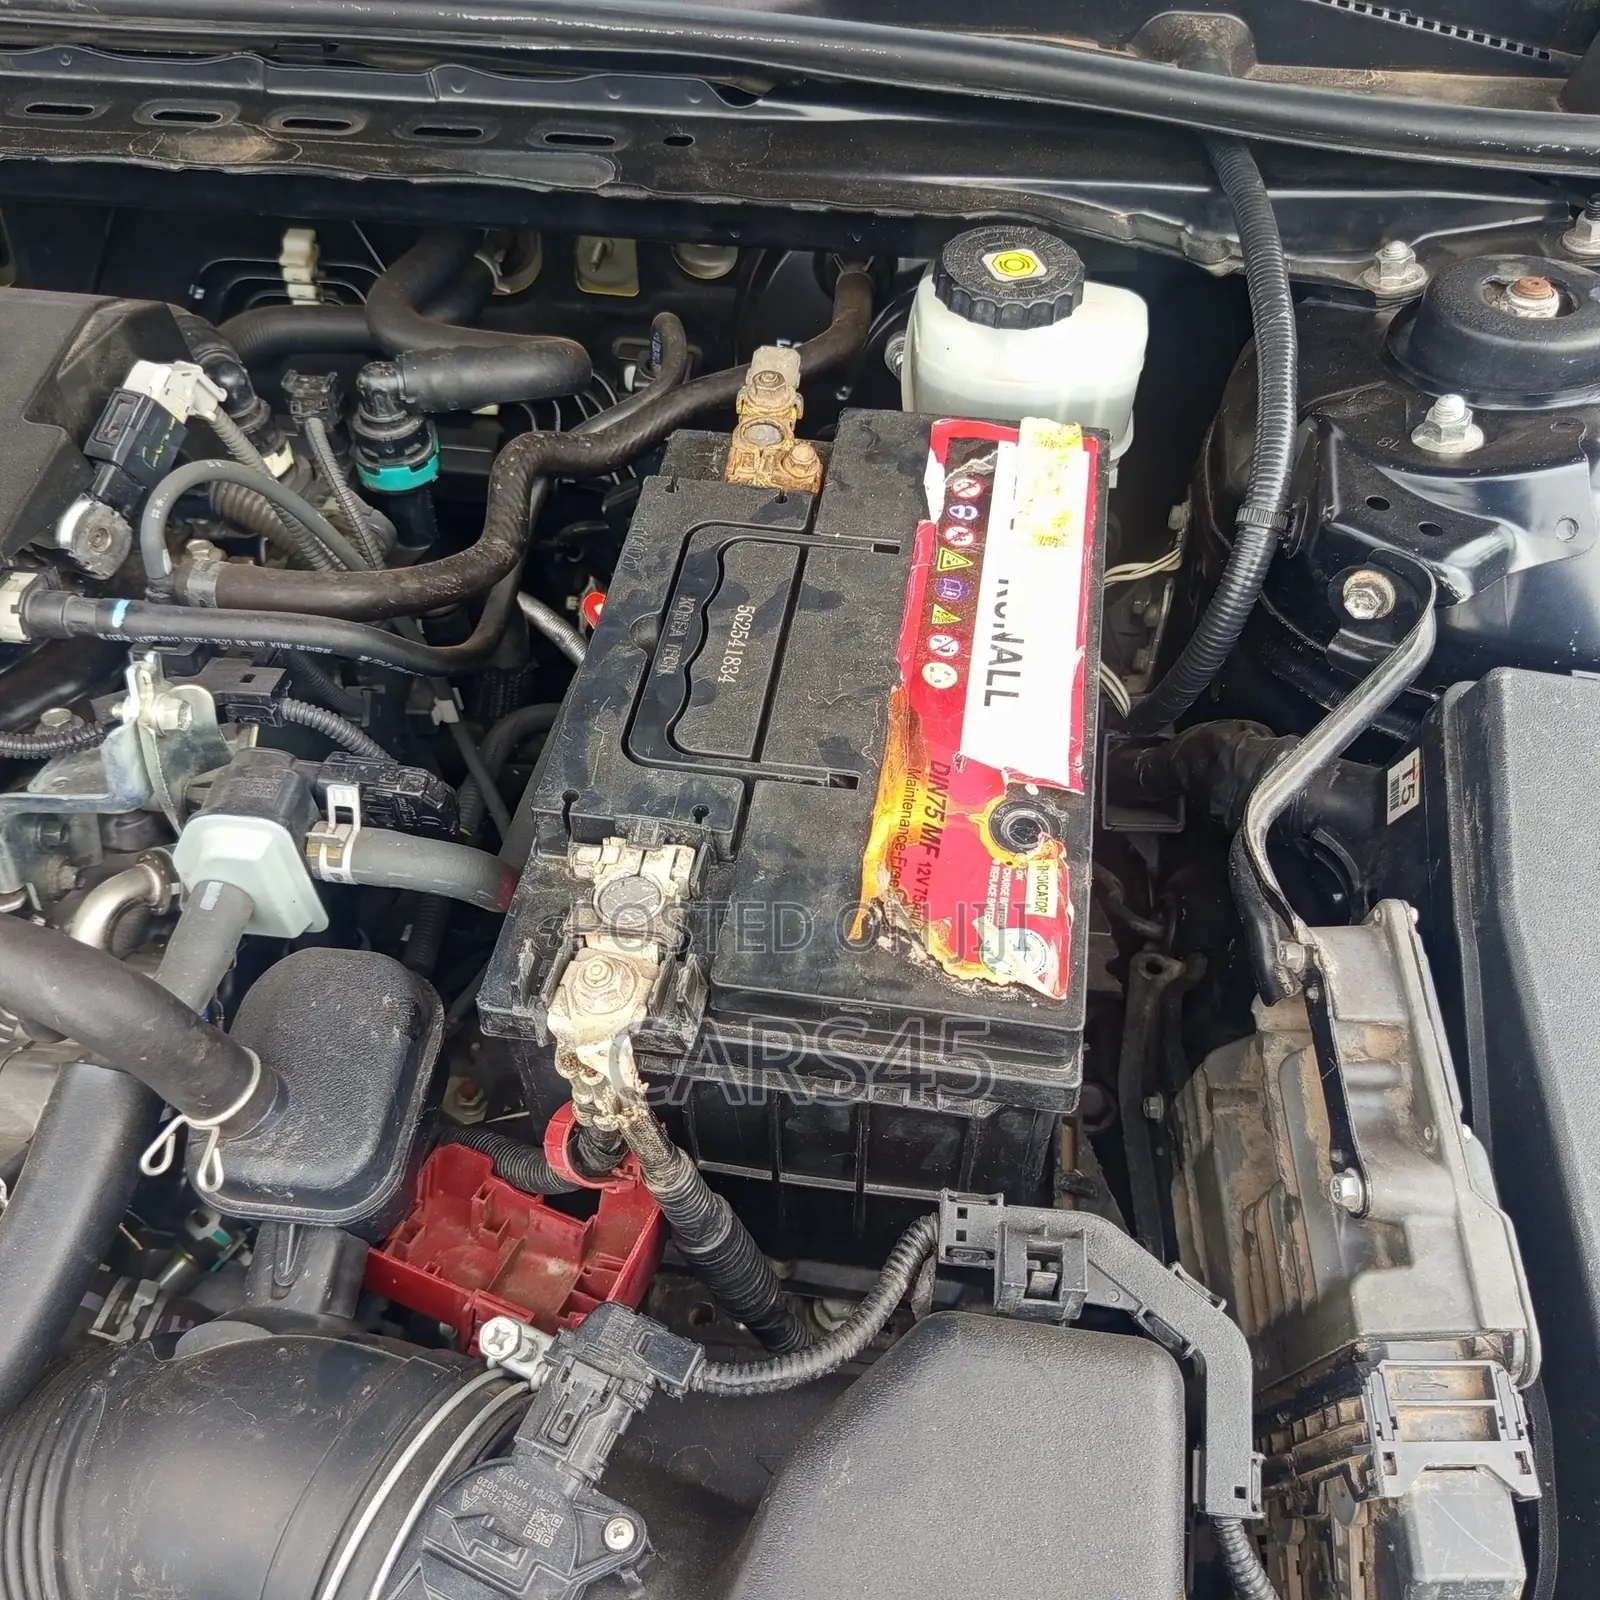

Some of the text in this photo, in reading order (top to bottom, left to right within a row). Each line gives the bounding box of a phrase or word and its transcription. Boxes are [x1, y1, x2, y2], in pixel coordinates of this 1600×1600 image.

[656, 597, 696, 677] KOREA TECH
[717, 604, 756, 683] 5G2541834
[924, 759, 950, 823] DIN75
[1401, 757, 1416, 805] T5
[888, 768, 922, 888] Maintenance-Free
[918, 822, 943, 859] MF
[916, 862, 932, 886] 12V
[987, 866, 1000, 897] REPLACE
[1000, 867, 1012, 896] CHARGE
[1015, 870, 1024, 881] OK
